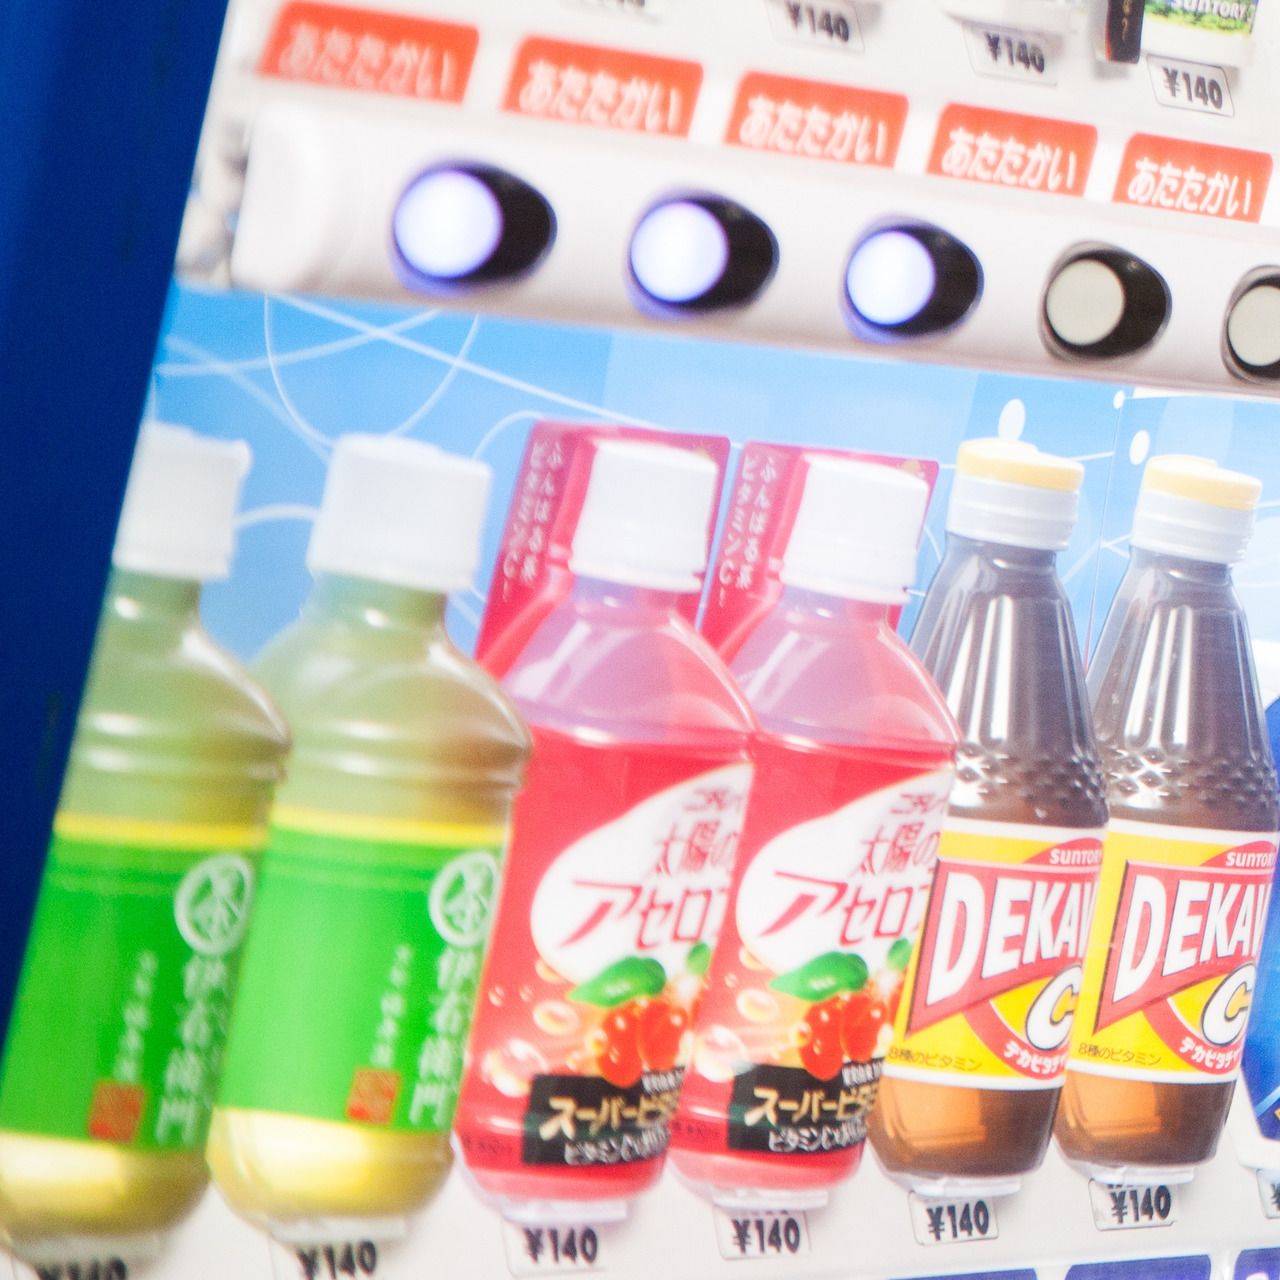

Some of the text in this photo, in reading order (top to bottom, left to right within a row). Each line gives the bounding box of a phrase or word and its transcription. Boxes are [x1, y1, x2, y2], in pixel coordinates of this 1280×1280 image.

[786, 2, 851, 44] ¥140
[984, 33, 1046, 74] ¥140
[519, 59, 682, 134] あたたかい
[1162, 69, 1224, 111] ¥140
[740, 94, 887, 163] あたたかい
[943, 126, 1077, 191] あたたかい
[1128, 155, 1252, 217] あたたかい
[888, 1046, 984, 1072] 8種のビタミン
[1078, 1041, 1162, 1066] 8種のビタミン
[926, 1201, 990, 1239] ¥140
[1110, 1187, 1172, 1223] ¥140
[525, 1226, 599, 1264] ¥140
[732, 1218, 802, 1253] ¥140
[301, 1240, 378, 1279] ¥140
